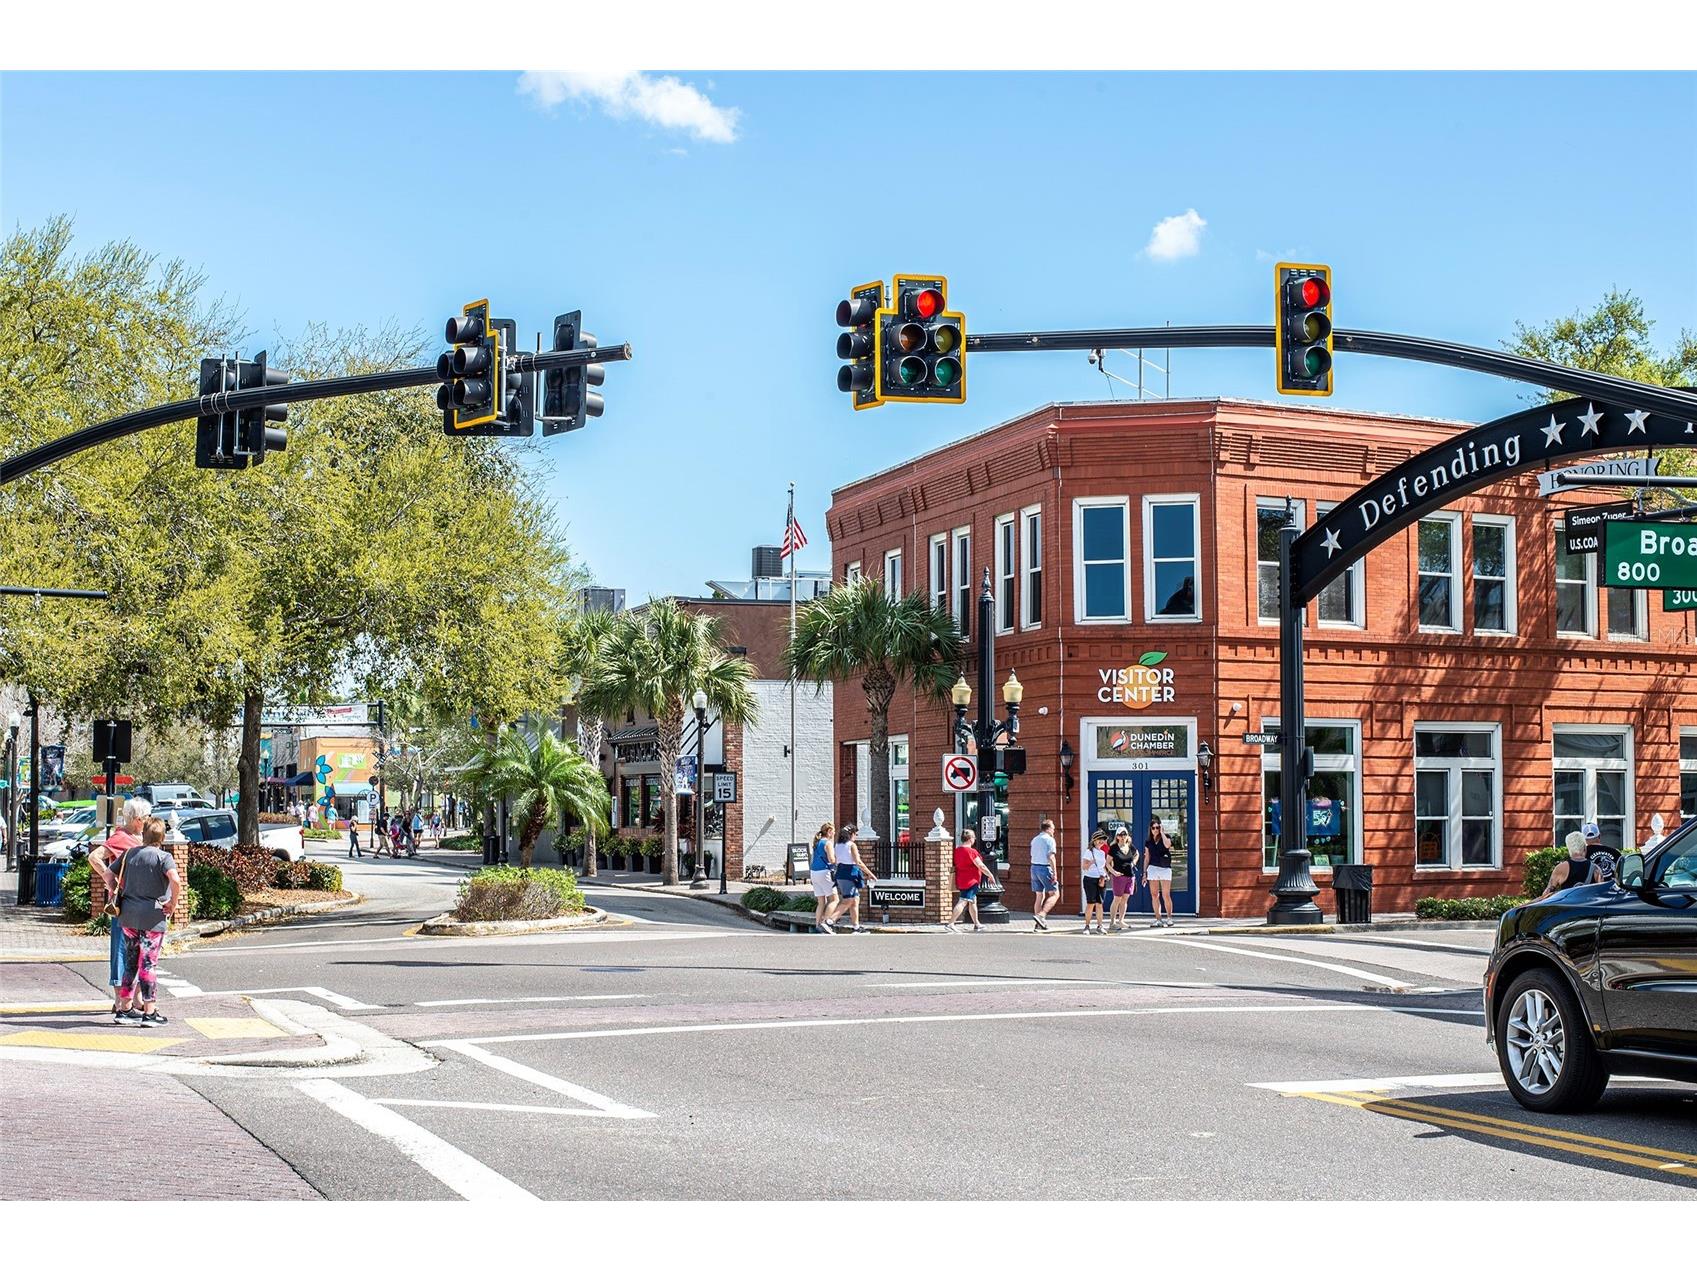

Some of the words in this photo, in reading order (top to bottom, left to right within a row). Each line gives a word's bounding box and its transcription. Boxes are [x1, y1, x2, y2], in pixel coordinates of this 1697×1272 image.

[1358, 434, 1521, 531] Defending
[1617, 561, 1661, 582] 800
[1098, 668, 1175, 685] VISITOR
[1097, 686, 1175, 703] CENTER
[1245, 734, 1278, 743] BROADWAY
[1130, 741, 1175, 750] CHAMBER
[1131, 762, 1149, 770] 301
[369, 793, 377, 803] P
[718, 787, 731, 799] 15
[874, 891, 920, 901] WELCOME
